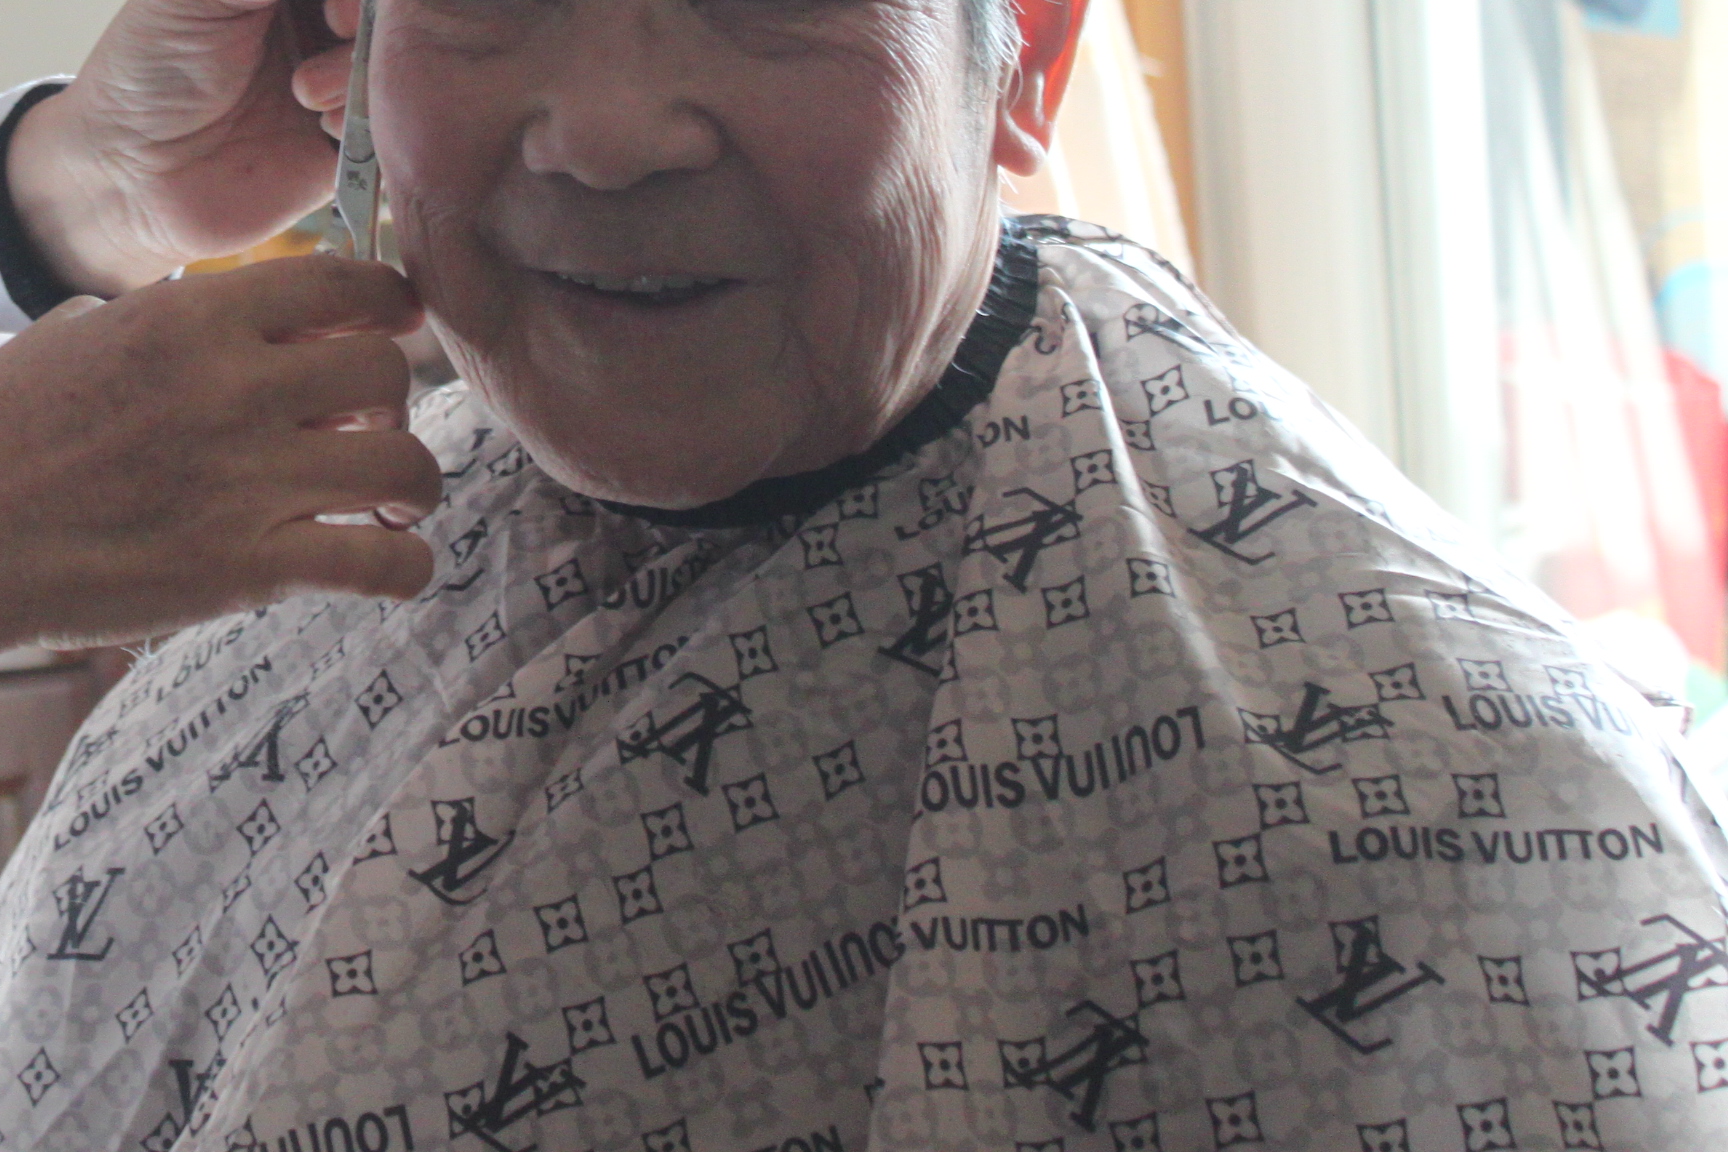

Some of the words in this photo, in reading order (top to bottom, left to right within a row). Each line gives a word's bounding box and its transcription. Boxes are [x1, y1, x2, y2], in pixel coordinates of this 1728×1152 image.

[1443, 694, 1575, 731] LOUIS
[54, 768, 143, 852] LOUIS
[1329, 827, 1464, 864] LOUIS
[1471, 823, 1664, 865] VUITTON
[910, 903, 1089, 953] VUITTON
[631, 991, 758, 1079] LOUIS
